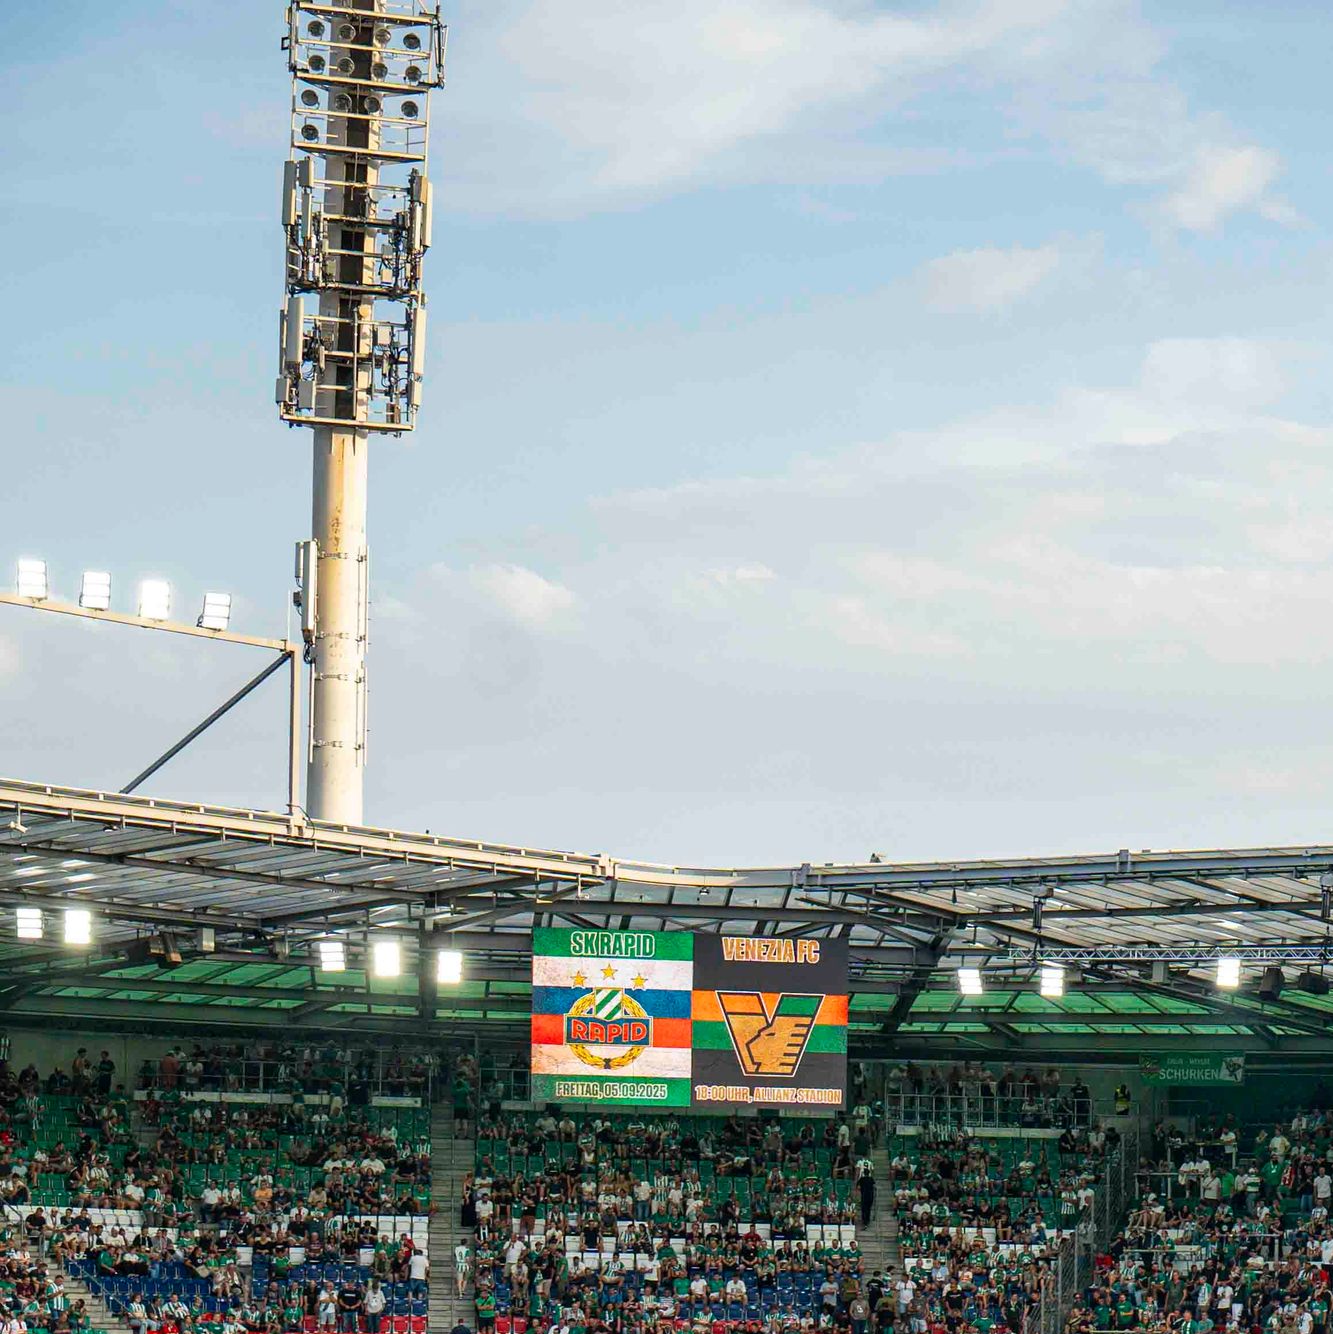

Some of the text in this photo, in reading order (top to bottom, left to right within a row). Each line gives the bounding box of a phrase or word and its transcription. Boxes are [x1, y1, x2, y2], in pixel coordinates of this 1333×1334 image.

[571, 932, 655, 957] SK RAPID
[722, 937, 820, 964] VENEZIA FC
[571, 1019, 647, 1042] RAPID
[1160, 1069, 1220, 1080] SCHURKEN
[555, 1082, 668, 1099] FREITAG, 05.09.2025
[695, 1085, 842, 1104] 18:00 UHR, ALLIANZ STADION
